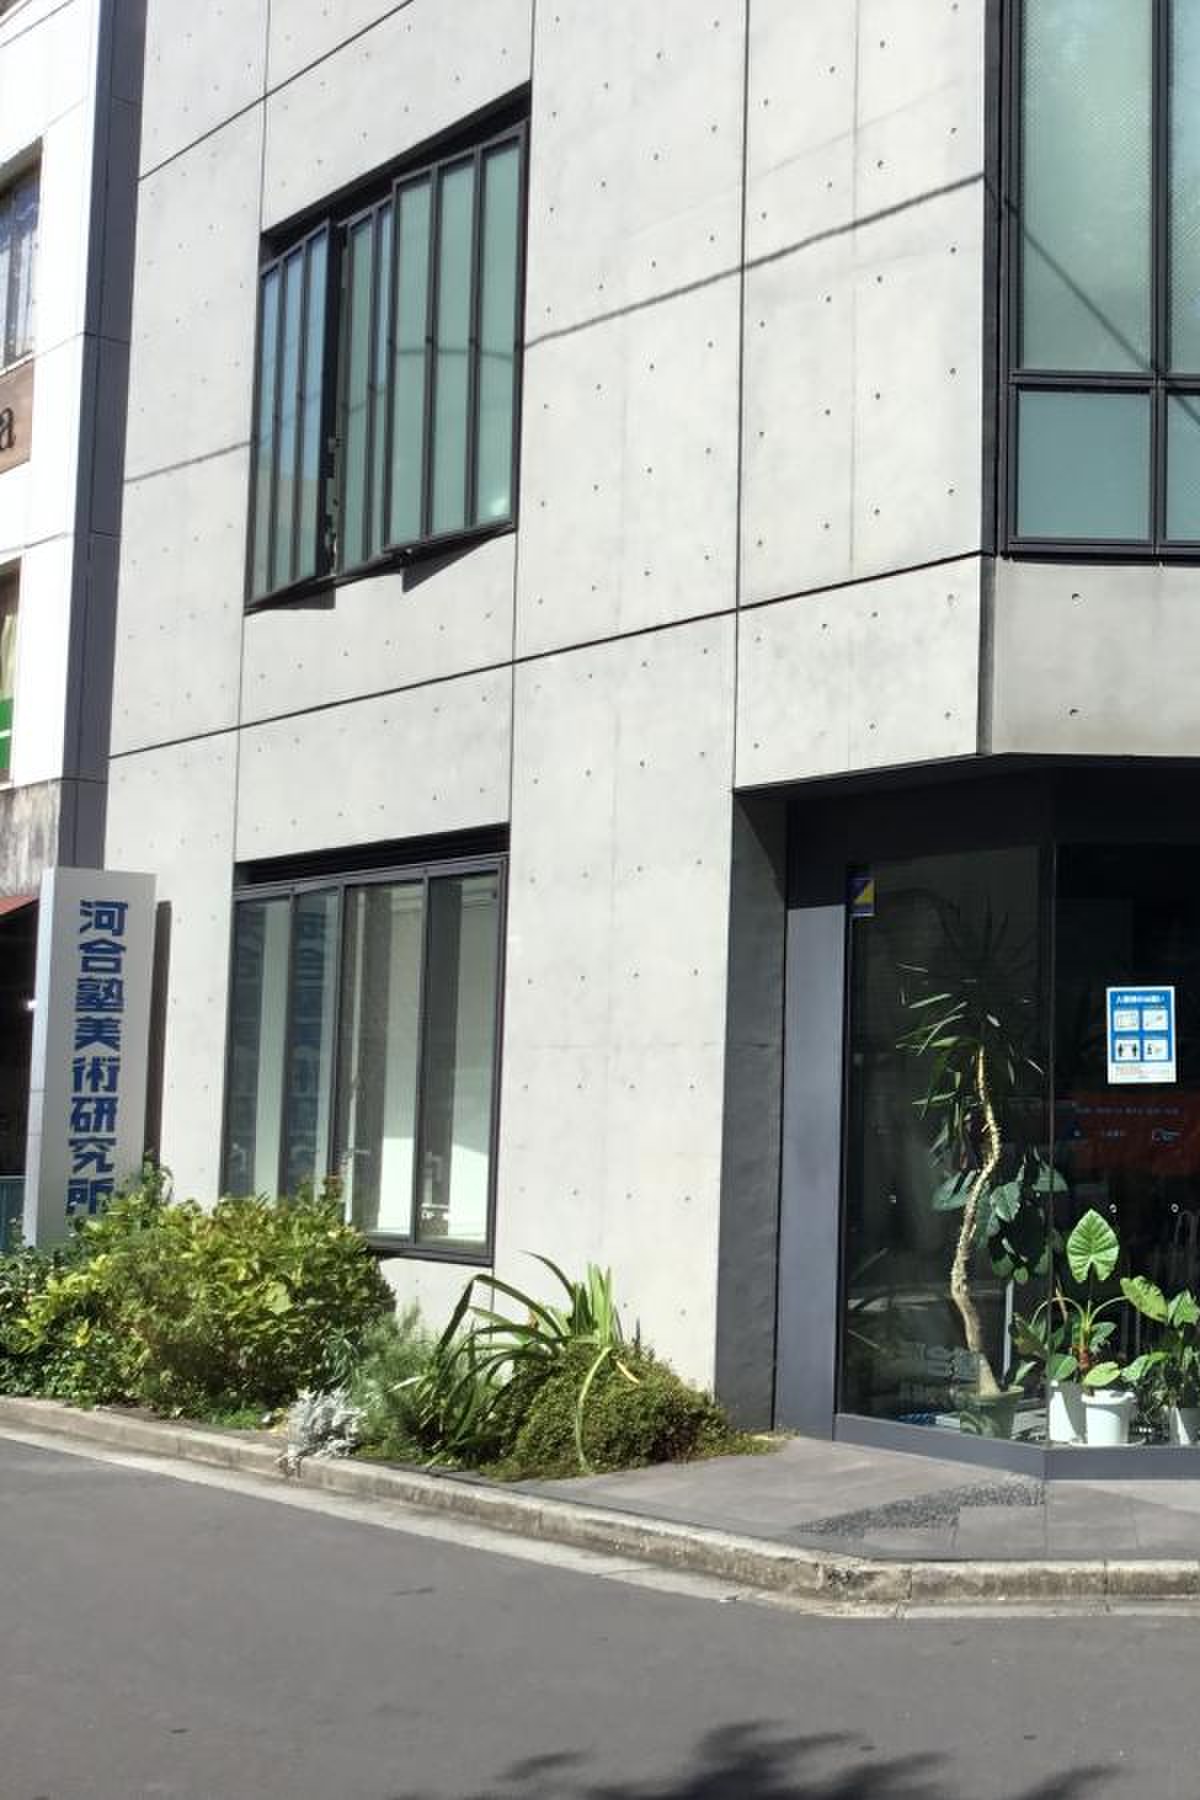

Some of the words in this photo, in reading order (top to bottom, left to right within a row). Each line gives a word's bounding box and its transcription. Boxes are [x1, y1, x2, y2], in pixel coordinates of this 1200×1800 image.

[66, 900, 128, 1216] 河合塾美術研究所
